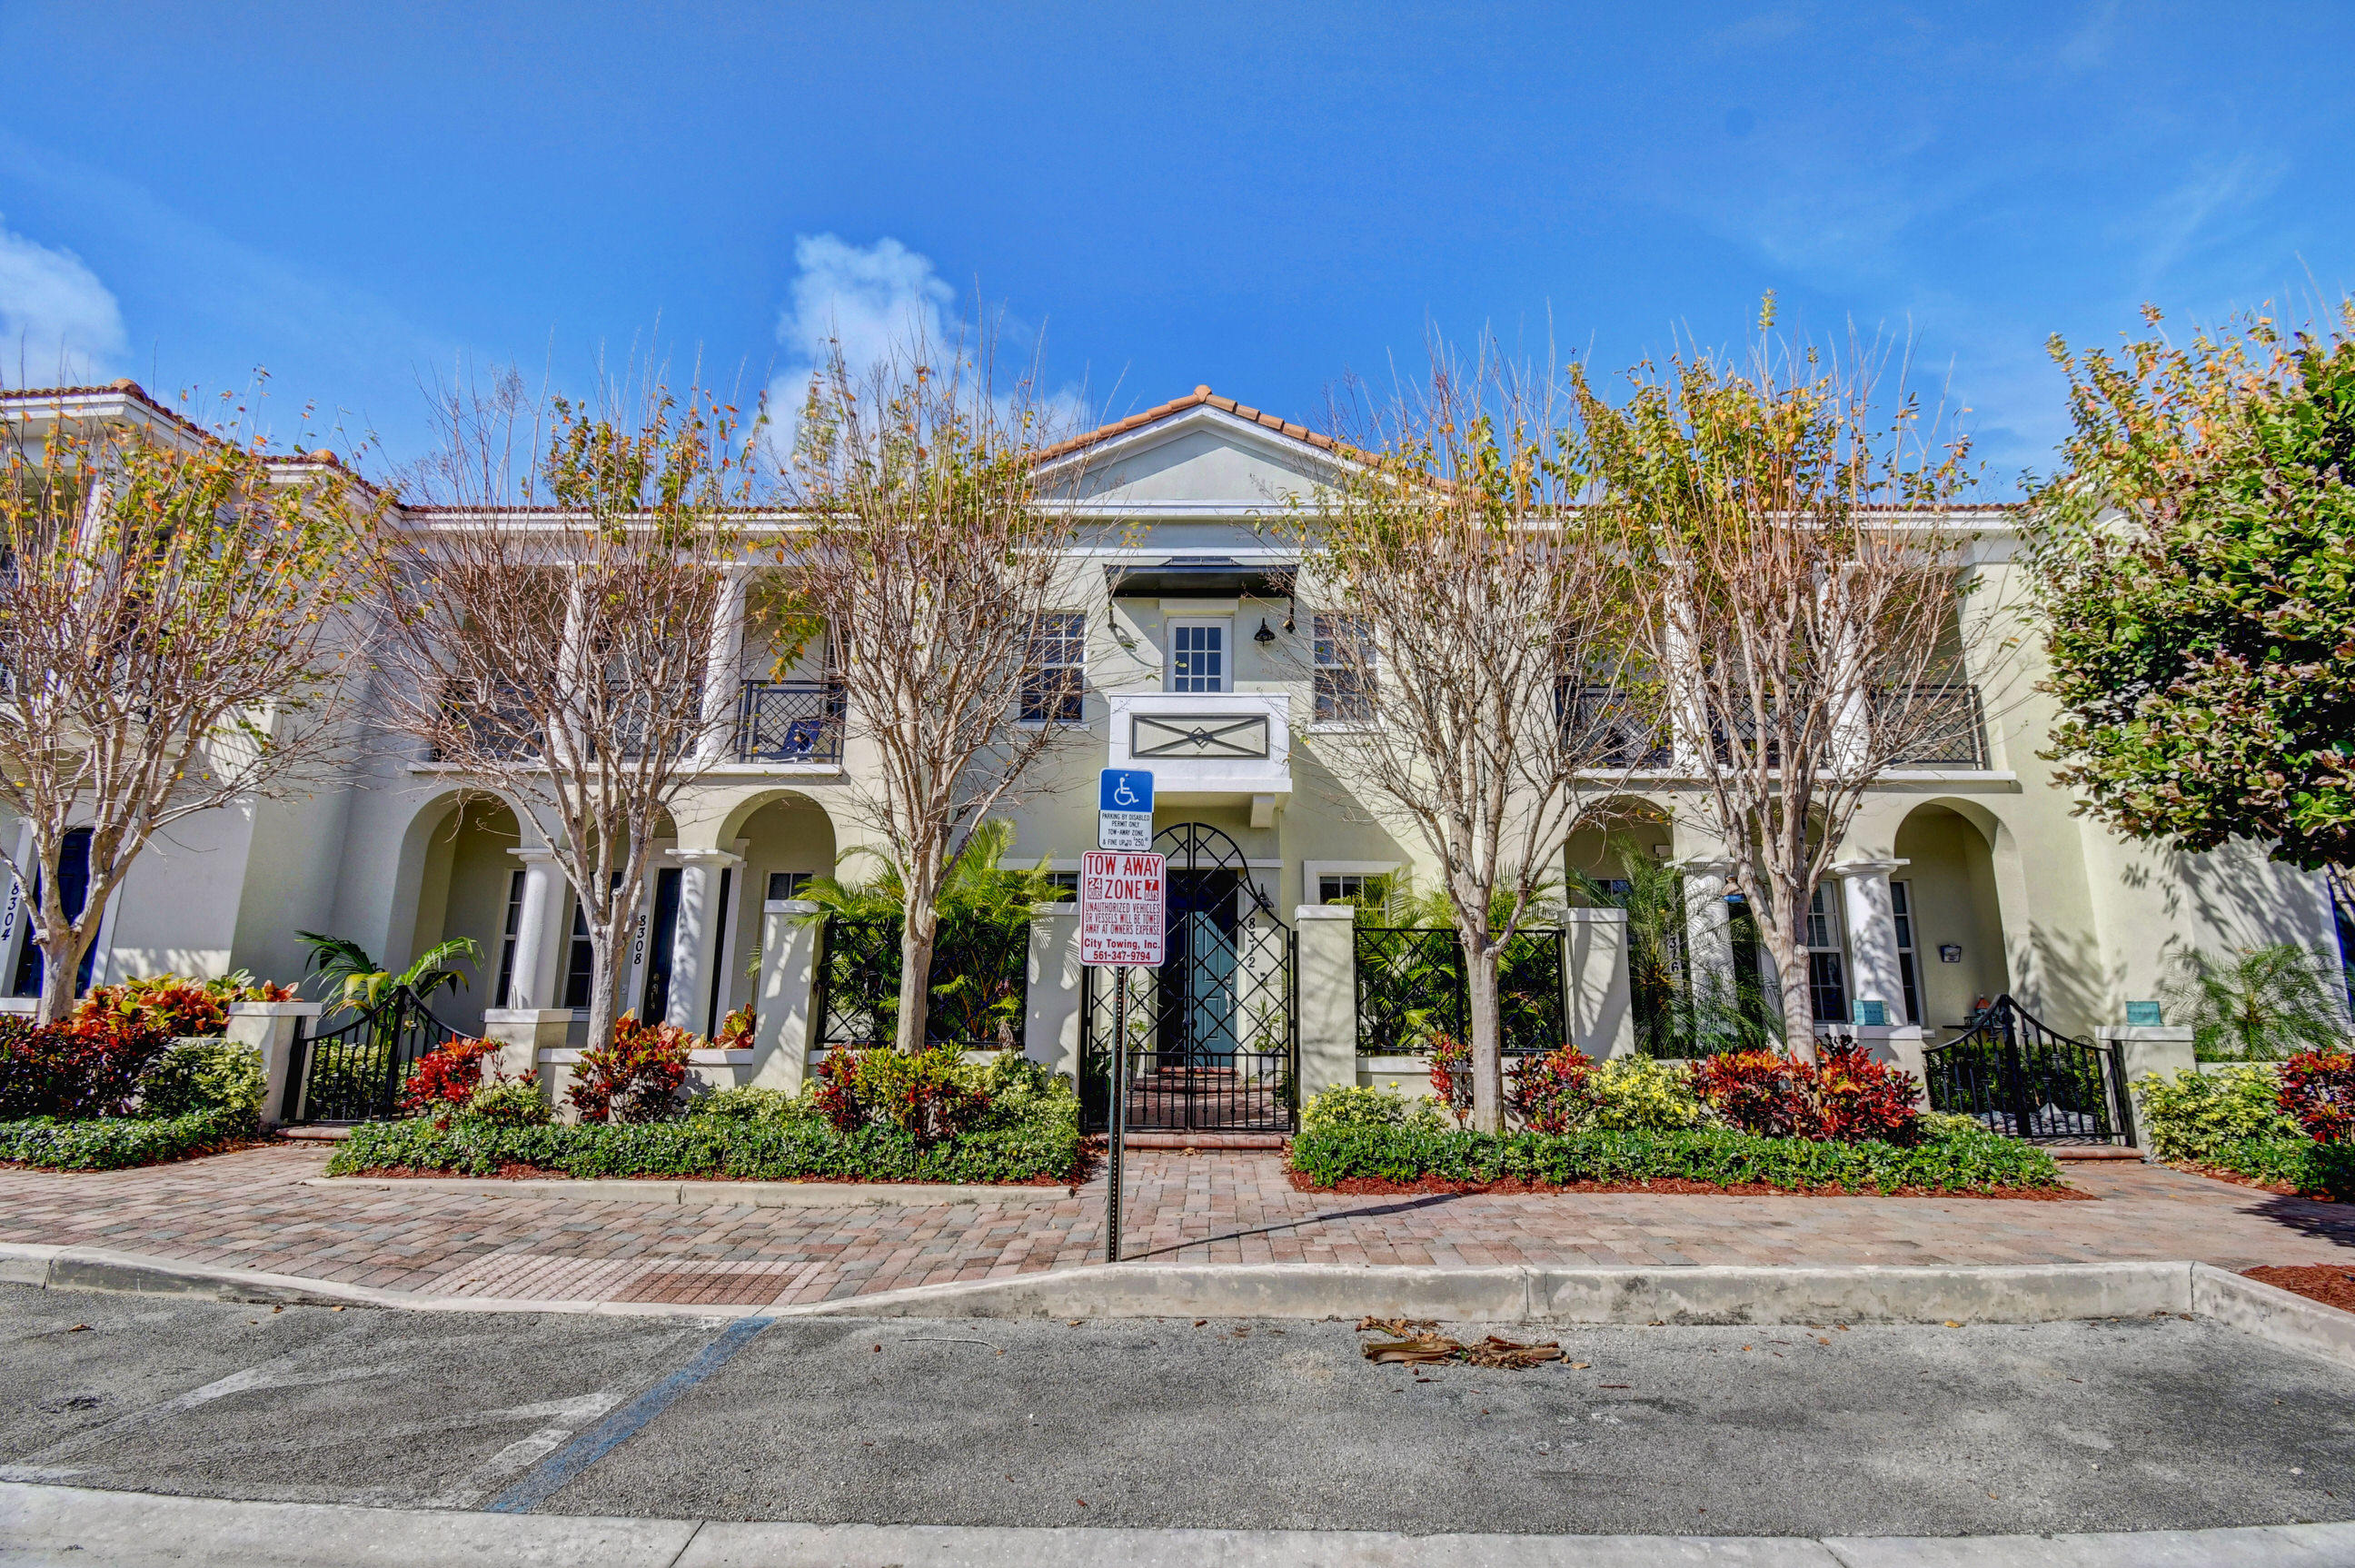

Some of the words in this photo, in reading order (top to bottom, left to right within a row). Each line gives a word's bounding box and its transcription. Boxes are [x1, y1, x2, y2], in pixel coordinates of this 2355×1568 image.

[1088, 855, 1117, 875] TOW
[1123, 856, 1160, 877] AWAY
[1088, 878, 1101, 889] 24
[1105, 879, 1142, 899] ZONE
[1148, 880, 1156, 890] 7
[1145, 889, 1158, 900] DAYS
[1, 882, 19, 940] 8304
[1086, 902, 1130, 913] UNAUTHORIZED
[1132, 903, 1160, 914] VEHICLES
[1085, 913, 1093, 923] OR
[1095, 913, 1118, 923] VESSELS
[1119, 914, 1131, 924] WILL
[1134, 914, 1140, 924] BE
[1143, 914, 1160, 925] TOWED
[1085, 924, 1099, 934] AWAY
[1102, 924, 1108, 934] AT
[1136, 925, 1160, 936] EXPENSE
[634, 915, 646, 965] 8308
[1084, 938, 1102, 948] City
[1106, 939, 1140, 950] Towing,
[1144, 939, 1160, 949] Inc.
[1247, 918, 1256, 968] 8312
[1093, 950, 1150, 960] 561-347-9794
